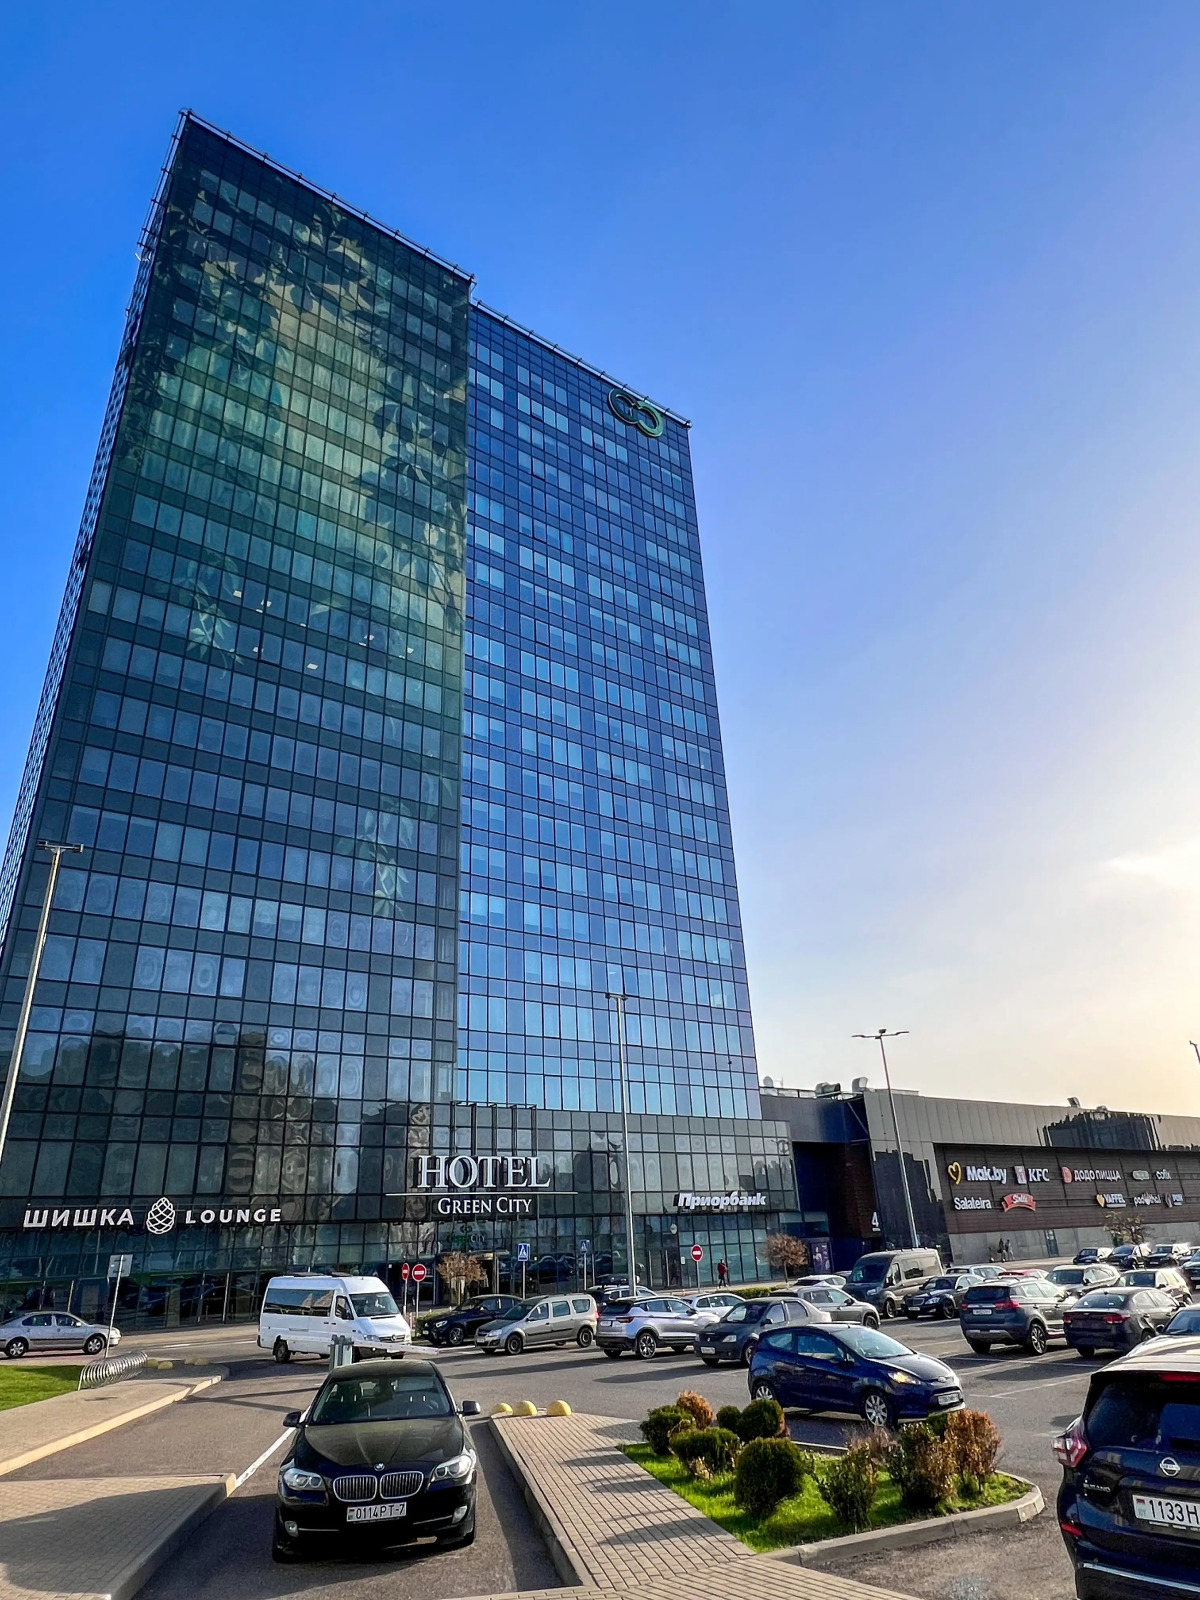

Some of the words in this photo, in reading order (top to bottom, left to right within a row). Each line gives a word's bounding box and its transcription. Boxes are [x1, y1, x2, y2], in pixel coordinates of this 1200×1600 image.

[416, 1155, 551, 1188] HOTEL
[966, 1166, 1007, 1185] Mak.by
[1028, 1168, 1050, 1182] KFC
[1073, 1169, 1096, 1182] ДОДО
[1095, 1169, 1122, 1182] ПИЦЦА
[677, 1191, 767, 1210] Приорбанк
[953, 1196, 992, 1210] Salateira
[23, 1208, 135, 1228] ШИШКА
[185, 1208, 282, 1225] LOUNGE
[871, 1211, 879, 1228] 4
